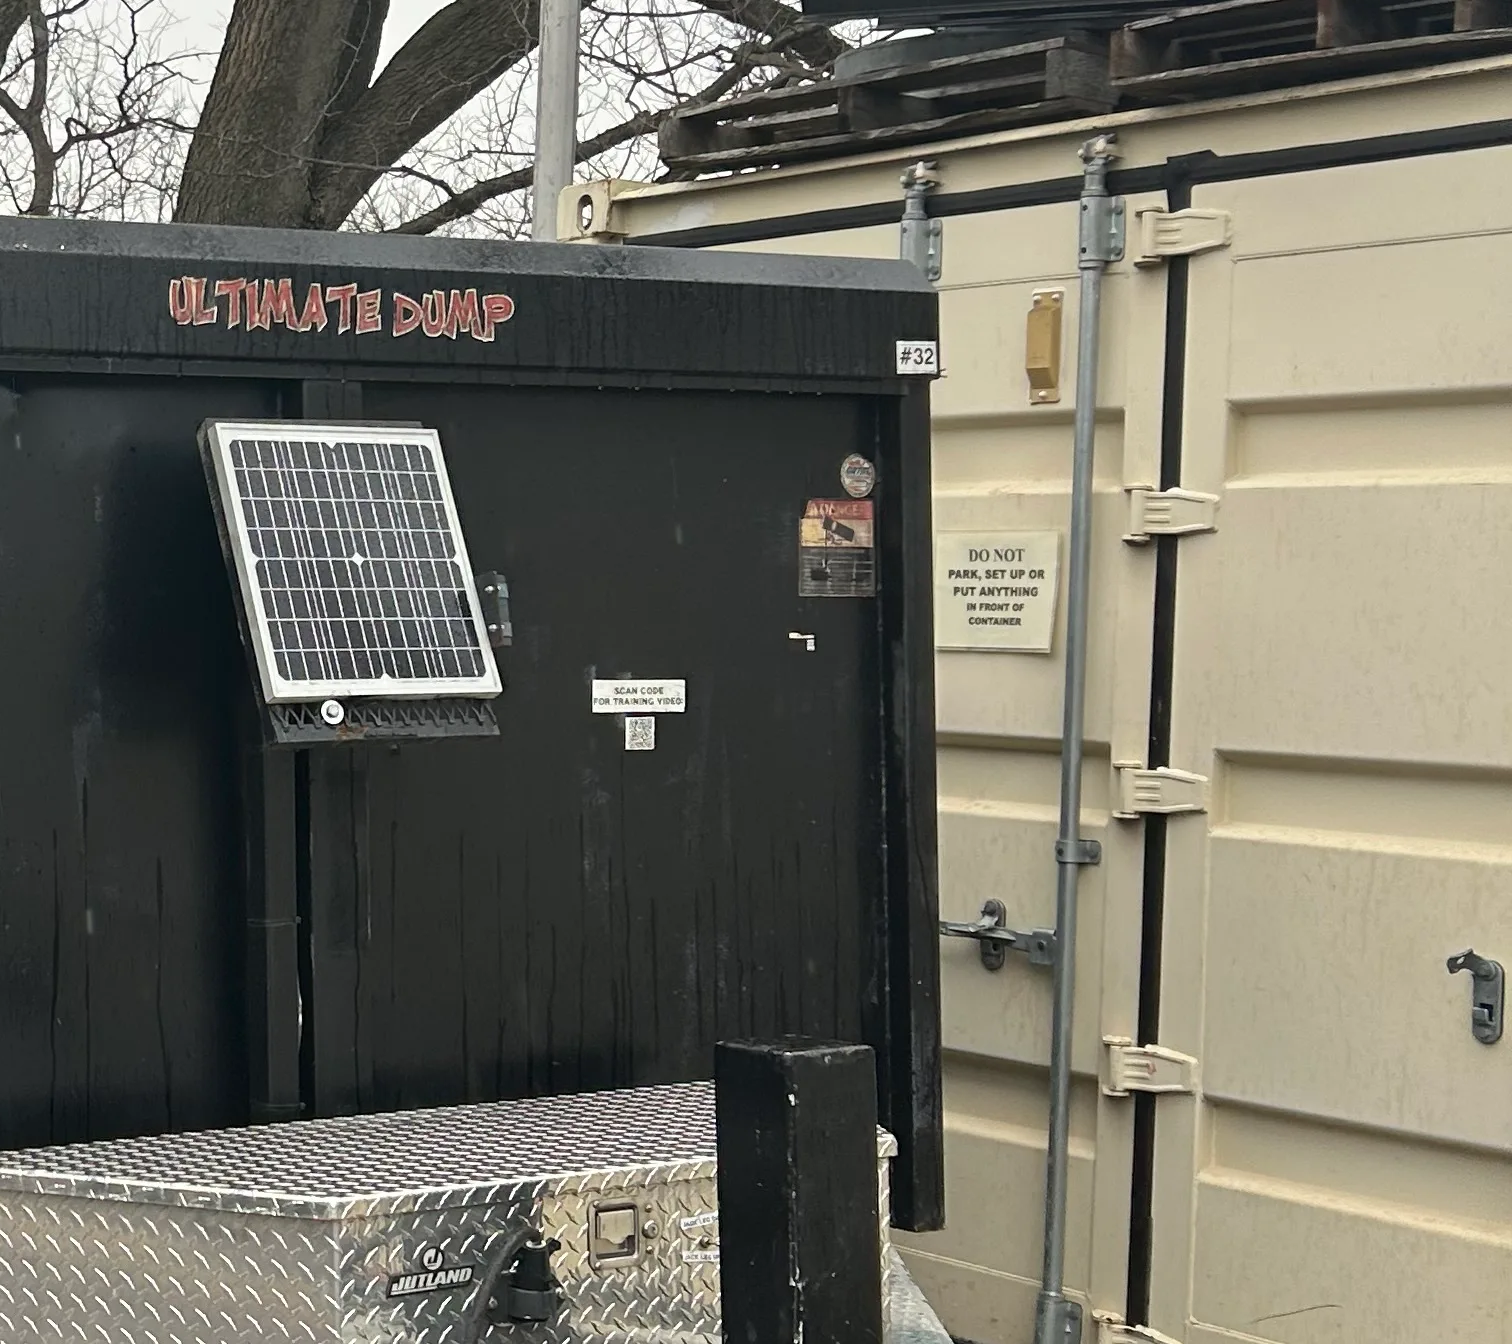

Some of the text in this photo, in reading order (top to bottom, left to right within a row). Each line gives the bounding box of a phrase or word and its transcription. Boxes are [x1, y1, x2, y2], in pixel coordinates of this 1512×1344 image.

[169, 276, 515, 342] ULTIMATE DUMP
[899, 346, 934, 365] #32
[968, 548, 1026, 563] DO NOT
[948, 569, 1045, 581] PARK, SET UP OR
[953, 586, 1039, 597] PUT ANYTHING
[966, 602, 1025, 612] IN FRONT OF
[968, 616, 1022, 626] CONTAINER
[614, 686, 664, 695] SCAN CODE
[593, 697, 610, 706] FOR
[612, 697, 655, 706] TRAINING
[391, 1267, 473, 1292] JUTLAND
